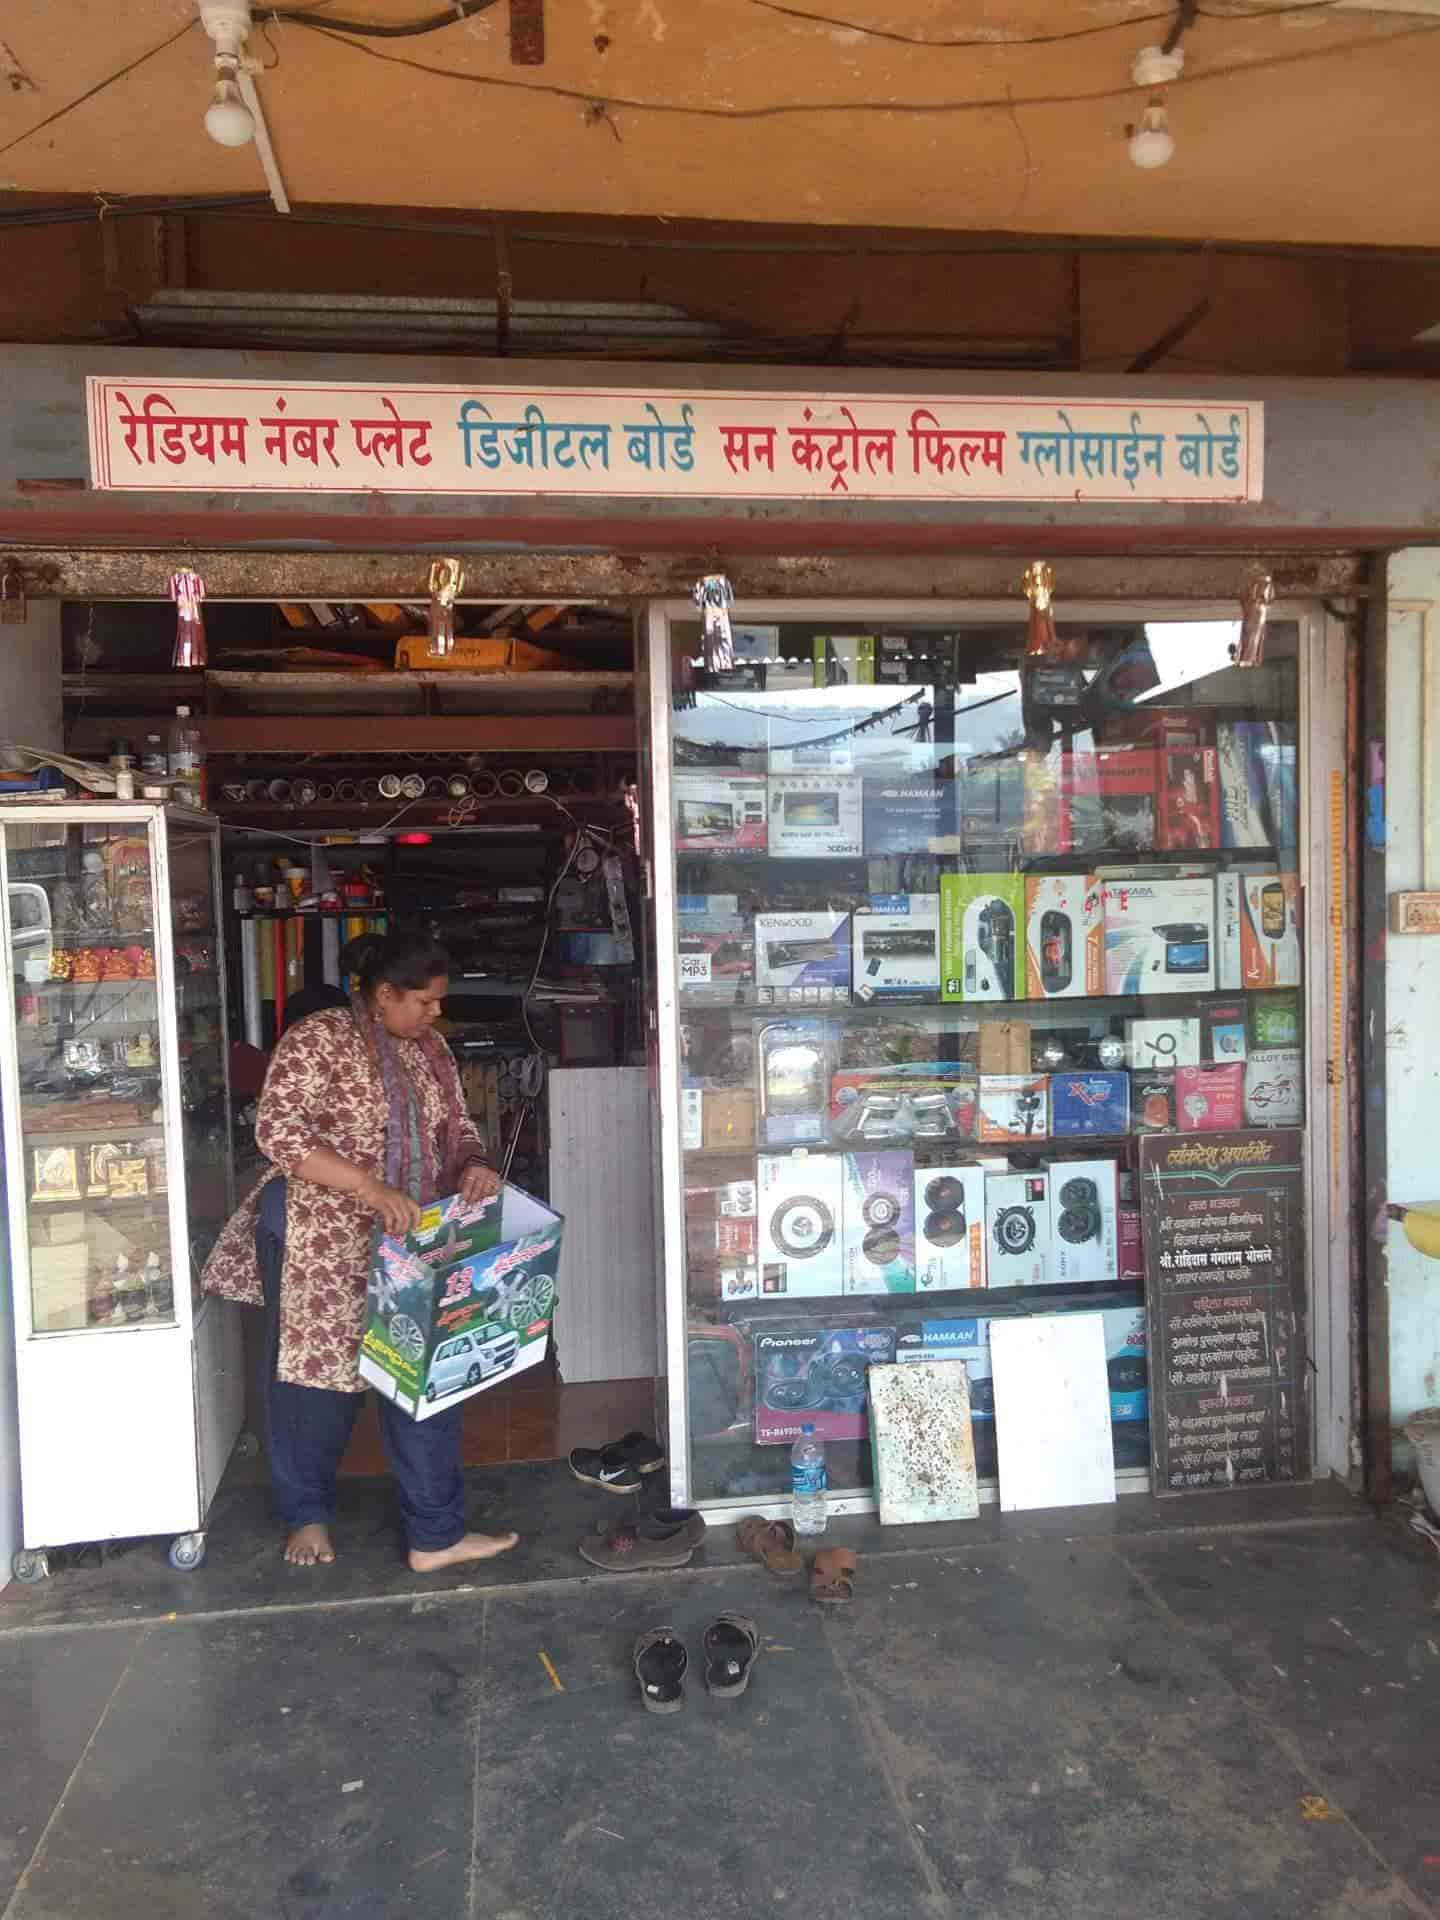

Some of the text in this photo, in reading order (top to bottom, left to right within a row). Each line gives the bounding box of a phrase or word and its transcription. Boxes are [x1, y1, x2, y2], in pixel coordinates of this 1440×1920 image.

[115, 392, 1240, 491] रेडियम नंबर प्लेट डिजीटल बोर्ड सन कंट्रोल फिल्म ग्लोसाईन बोर्ड
[759, 917, 813, 929] KENWOOD
[681, 966, 708, 976] MP3
[760, 1337, 817, 1348] Pioneer
